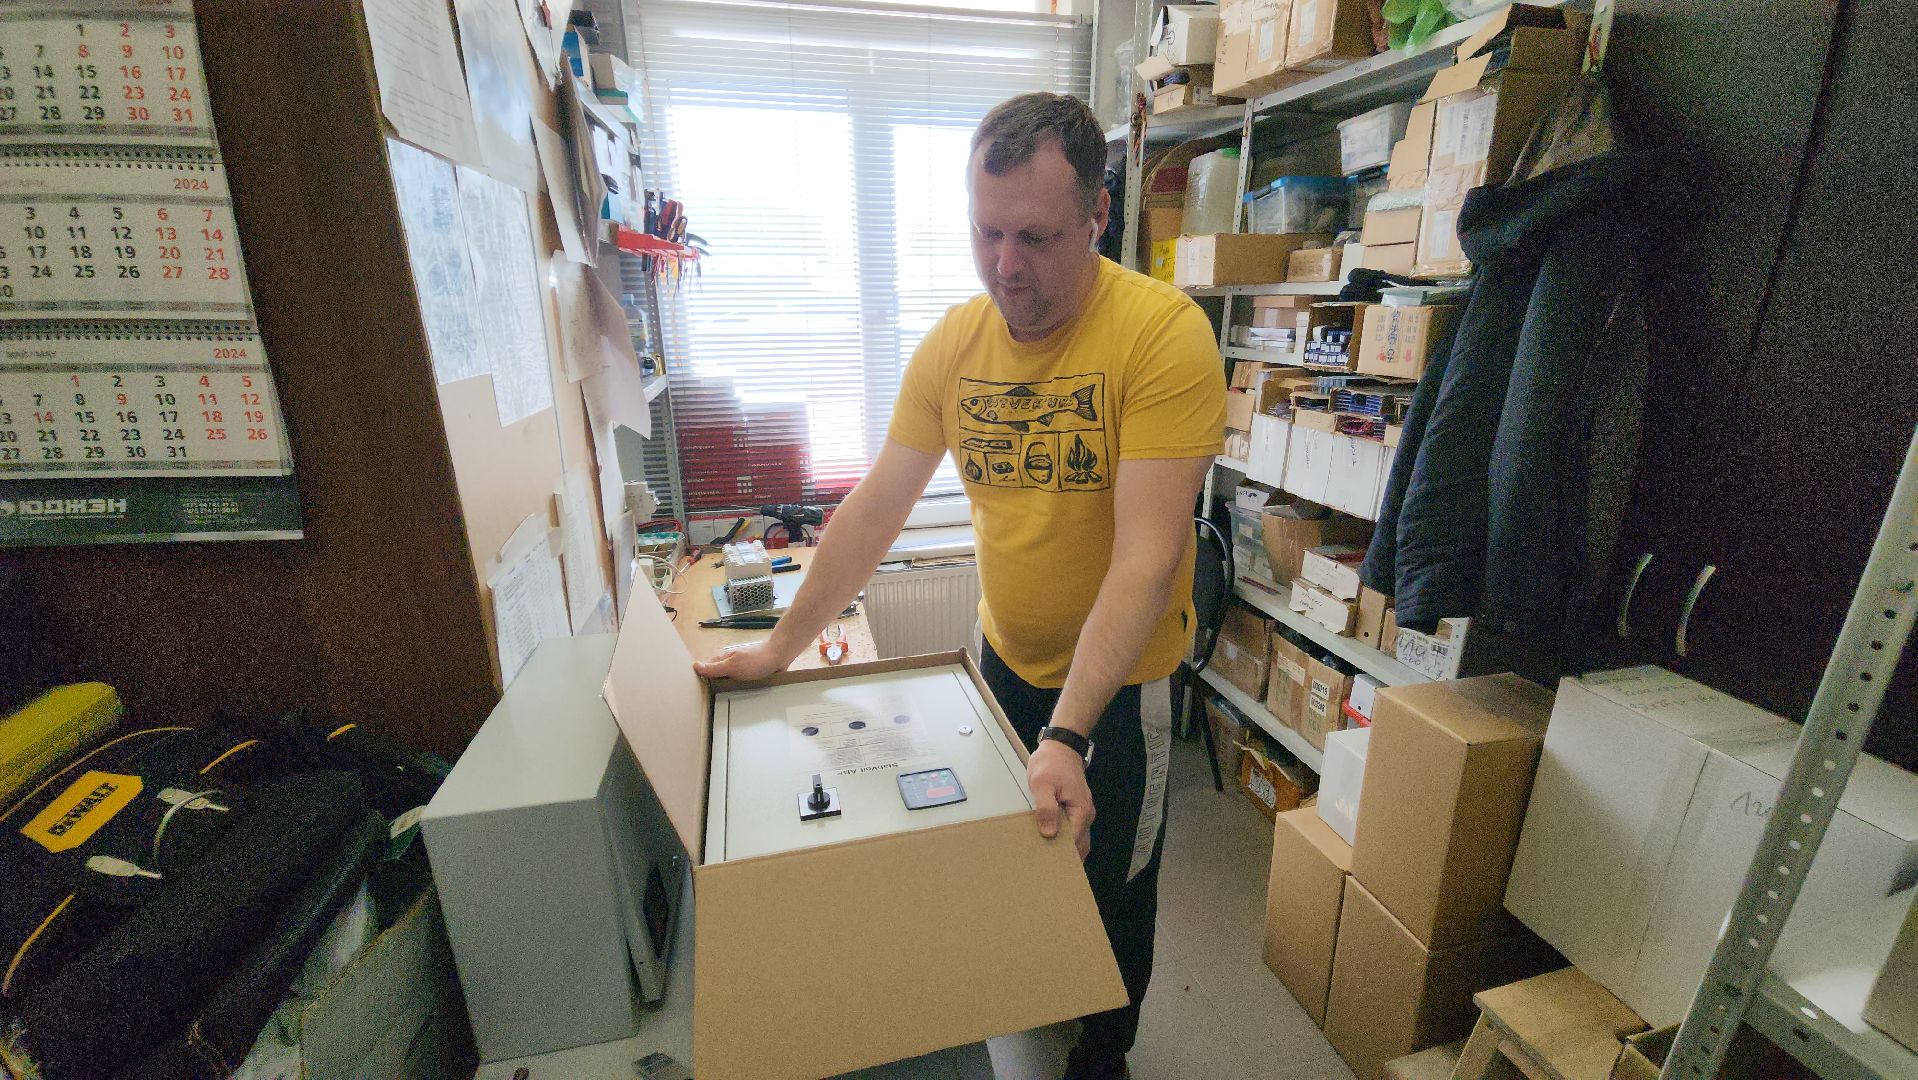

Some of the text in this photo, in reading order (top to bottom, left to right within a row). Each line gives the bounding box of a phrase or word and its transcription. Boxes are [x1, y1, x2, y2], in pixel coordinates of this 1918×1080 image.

[76, 23, 175, 38] 1 2 3
[35, 44, 184, 60] 7 8 9 10
[34, 65, 54, 78] 14
[76, 65, 97, 79] 15
[120, 66, 141, 79] 16
[167, 67, 186, 80] 17
[36, 86, 55, 99] 21
[79, 86, 100, 99] 22
[123, 86, 144, 99] 23
[170, 87, 191, 101] 24
[40, 106, 61, 120] 28
[83, 106, 104, 121] 29
[128, 107, 149, 120] 30
[173, 108, 192, 121] 31
[174, 178, 209, 190] 2024
[26, 207, 212, 222] 3 4 5 6 7
[24, 226, 222, 241] 10 11 12 13 14
[28, 246, 46, 258] 17
[70, 246, 92, 258] 18
[115, 246, 135, 259] 19
[159, 246, 181, 259] 20
[205, 248, 224, 260] 21
[31, 265, 52, 278] 24
[74, 265, 95, 278] 25
[118, 266, 140, 278] 26
[163, 265, 182, 278] 27
[208, 267, 229, 280] 28
[214, 348, 247, 358] 2024
[71, 375, 252, 388] 1 2 3 4 5
[34, 393, 260, 406] 7 8 9 10 11 12
[33, 412, 54, 424] 14
[75, 412, 95, 423] 15
[116, 411, 137, 423] 16
[160, 411, 178, 422] 17
[202, 411, 222, 422] 18
[245, 411, 263, 422] 19
[0, 428, 267, 442] 20 21 22 23 24 25 26
[3, 446, 186, 460] 27 28 29 30 31
[1135, 727, 1167, 854] AUTHENTIC
